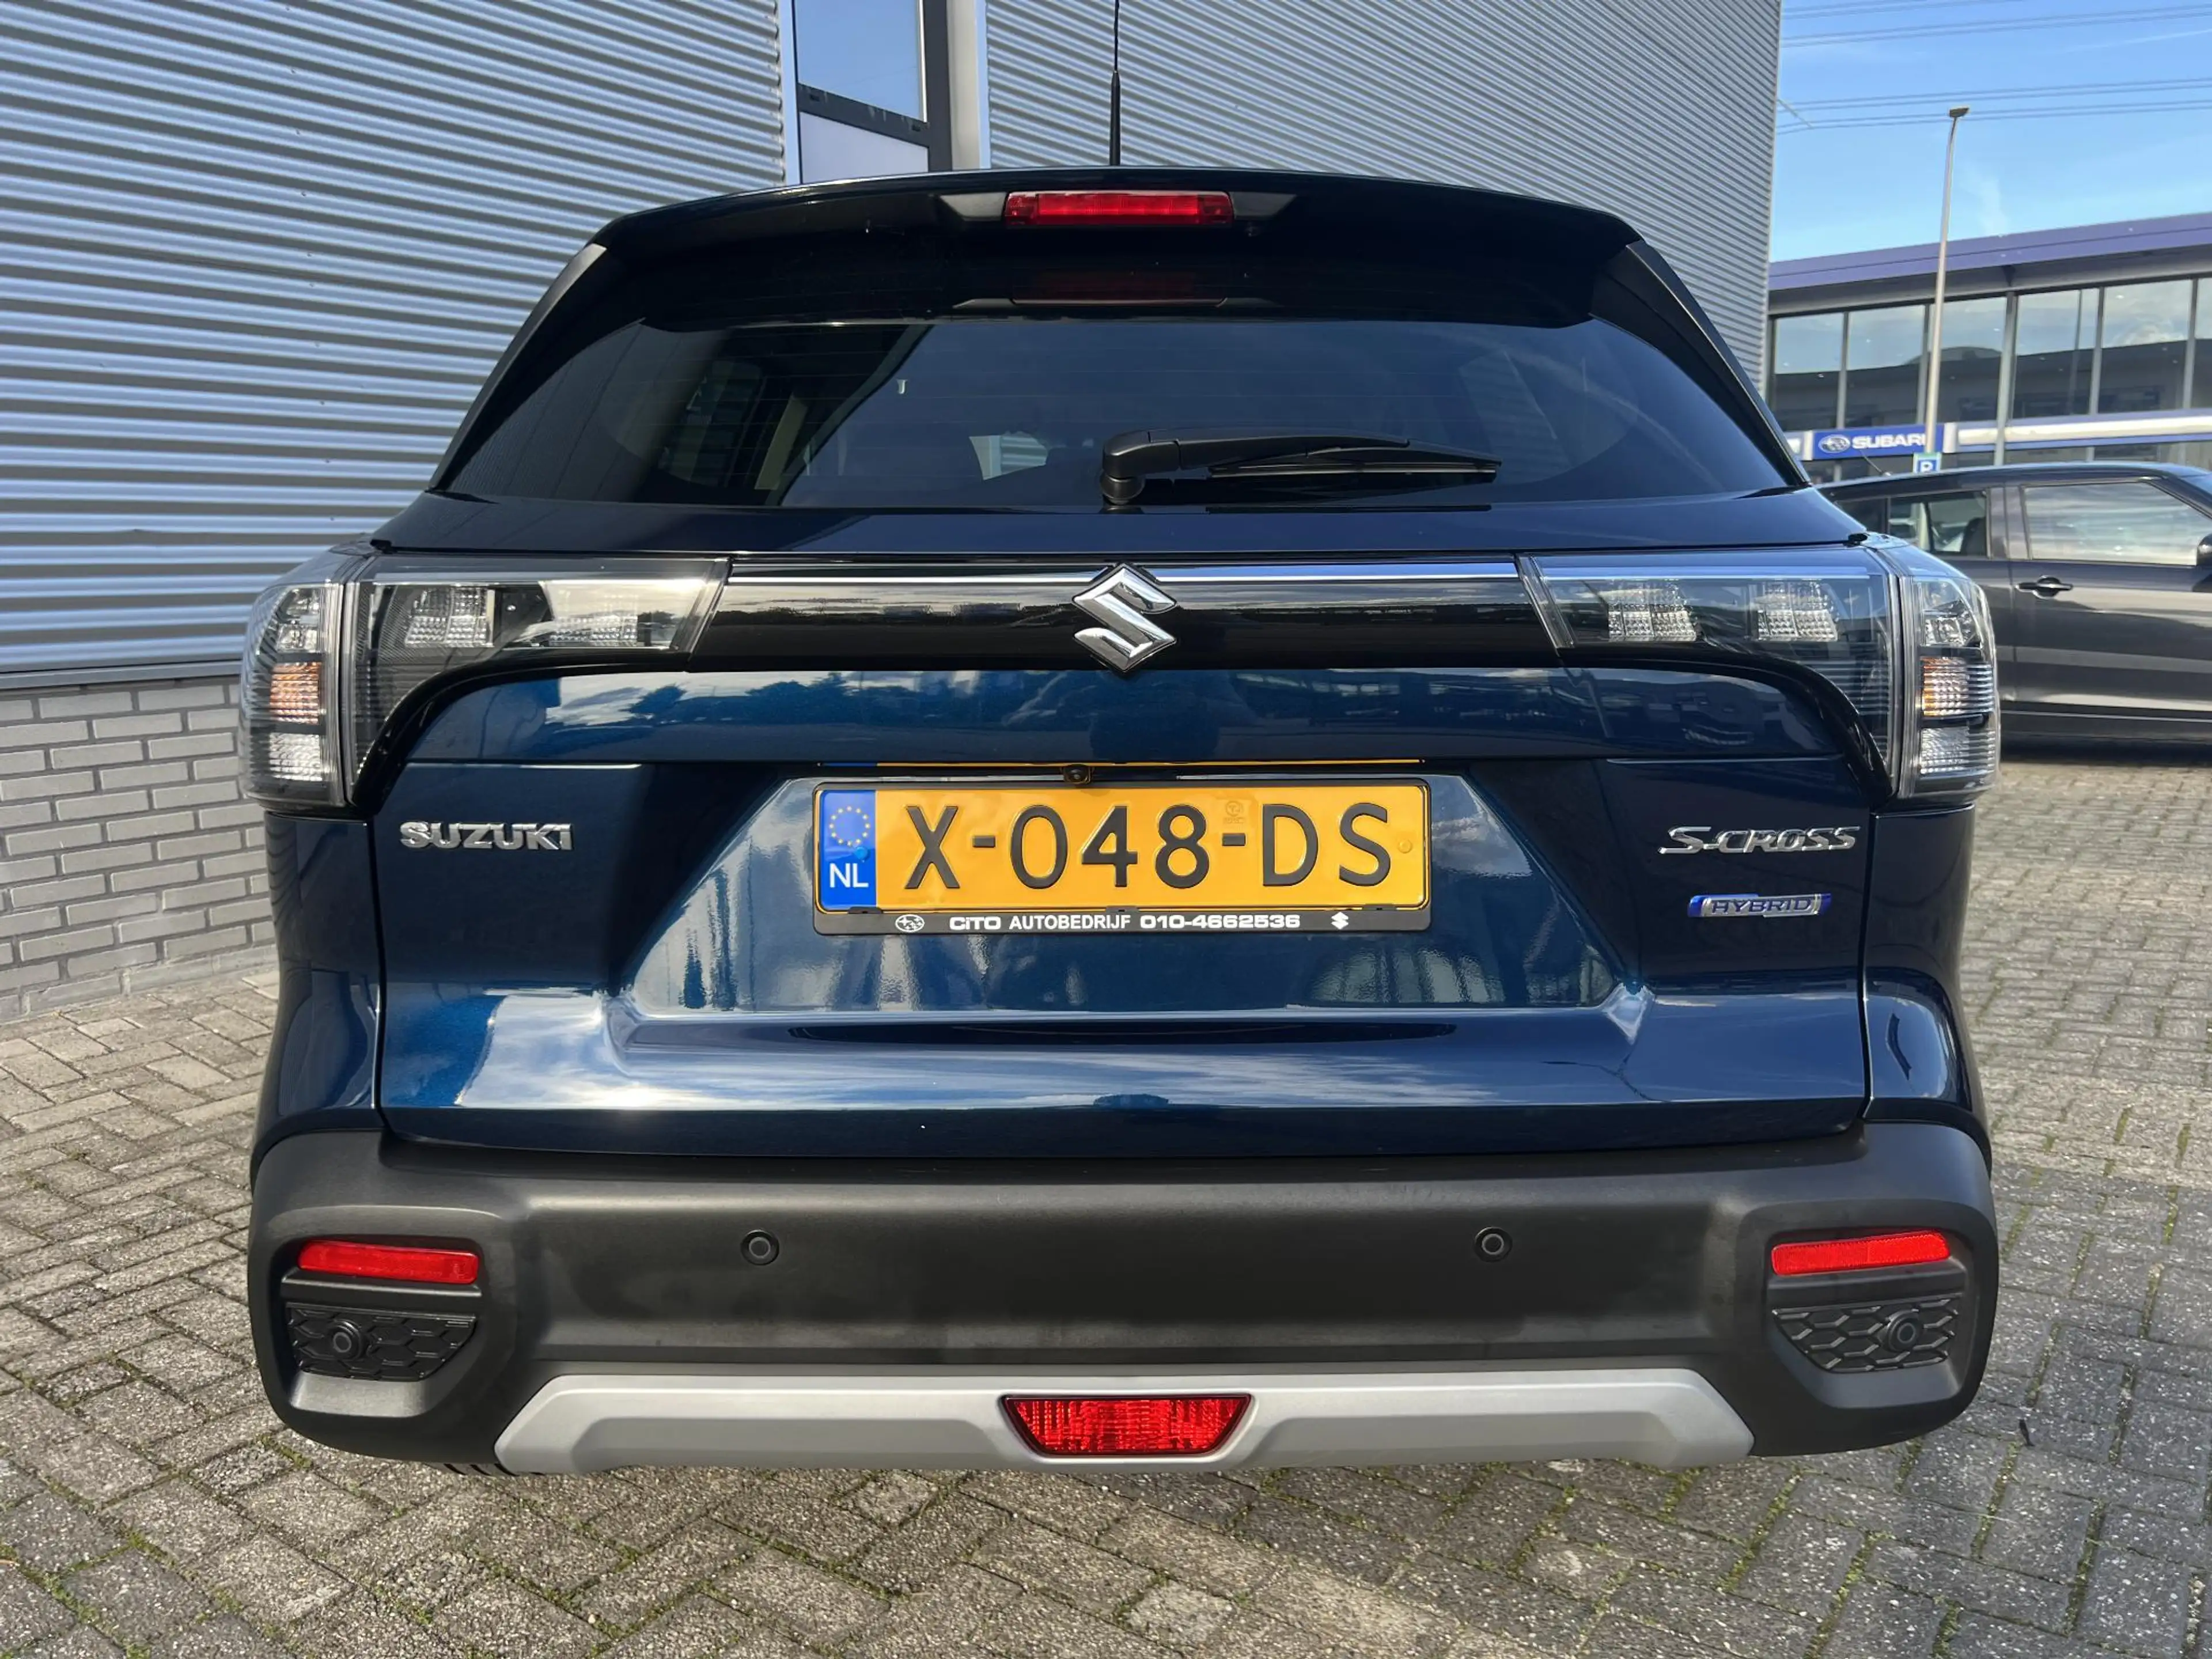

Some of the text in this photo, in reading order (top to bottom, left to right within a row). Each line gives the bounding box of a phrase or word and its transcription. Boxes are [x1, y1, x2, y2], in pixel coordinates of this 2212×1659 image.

[400, 820, 573, 850] SUZUKI
[904, 802, 1391, 889] X-048-DS
[1657, 825, 1861, 854] S-CROSS
[829, 863, 869, 888] NL
[1711, 899, 1813, 915] HYBRID
[1009, 915, 1131, 930] AUTOBEDRIJF
[1140, 915, 1300, 929] 010-4662536
